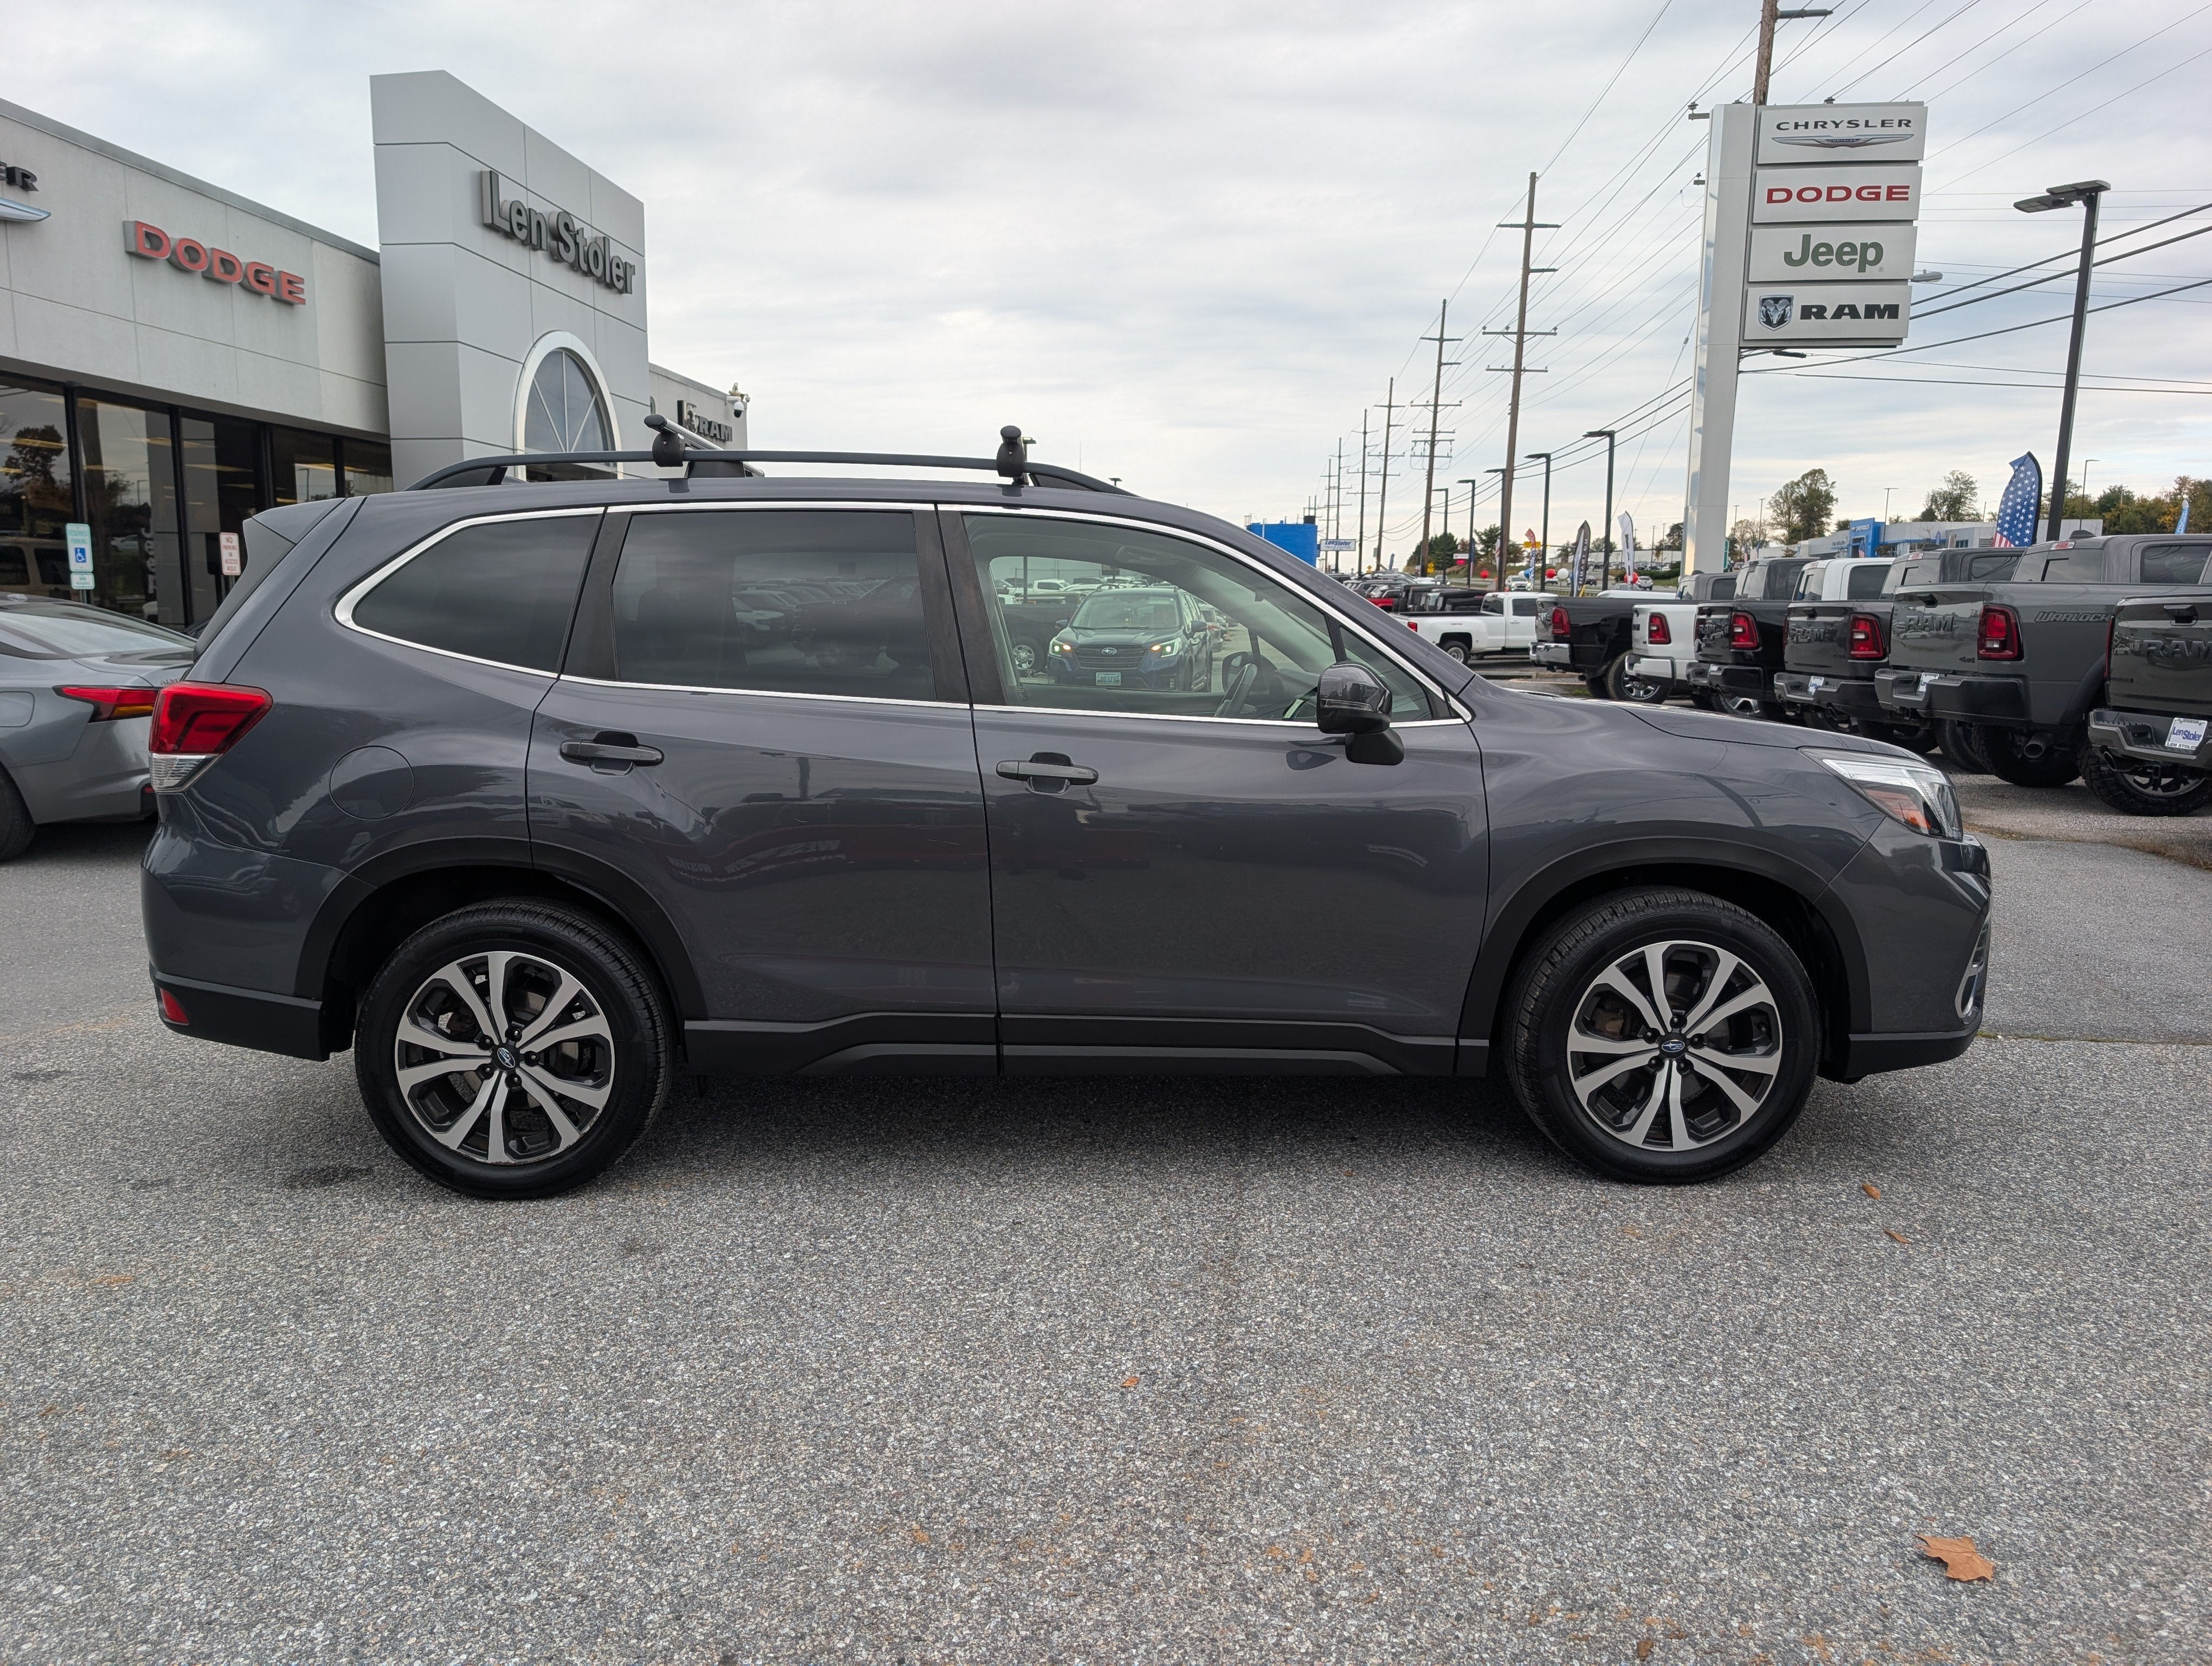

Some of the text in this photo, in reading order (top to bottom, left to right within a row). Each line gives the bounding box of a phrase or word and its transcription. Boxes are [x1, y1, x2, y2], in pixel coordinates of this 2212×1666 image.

[1776, 119, 1913, 131] CHRYSLER
[1766, 185, 1911, 204] DODGE
[481, 170, 636, 295] Len Stoler
[1784, 234, 1884, 273] Jeep
[124, 220, 306, 306] DODGE
[1799, 303, 1900, 321] RAM
[697, 415, 732, 443] RAM
[1906, 615, 1955, 632] RAM
[2034, 611, 2112, 623] WARLOCK
[2172, 726, 2202, 741] Len Stoler
